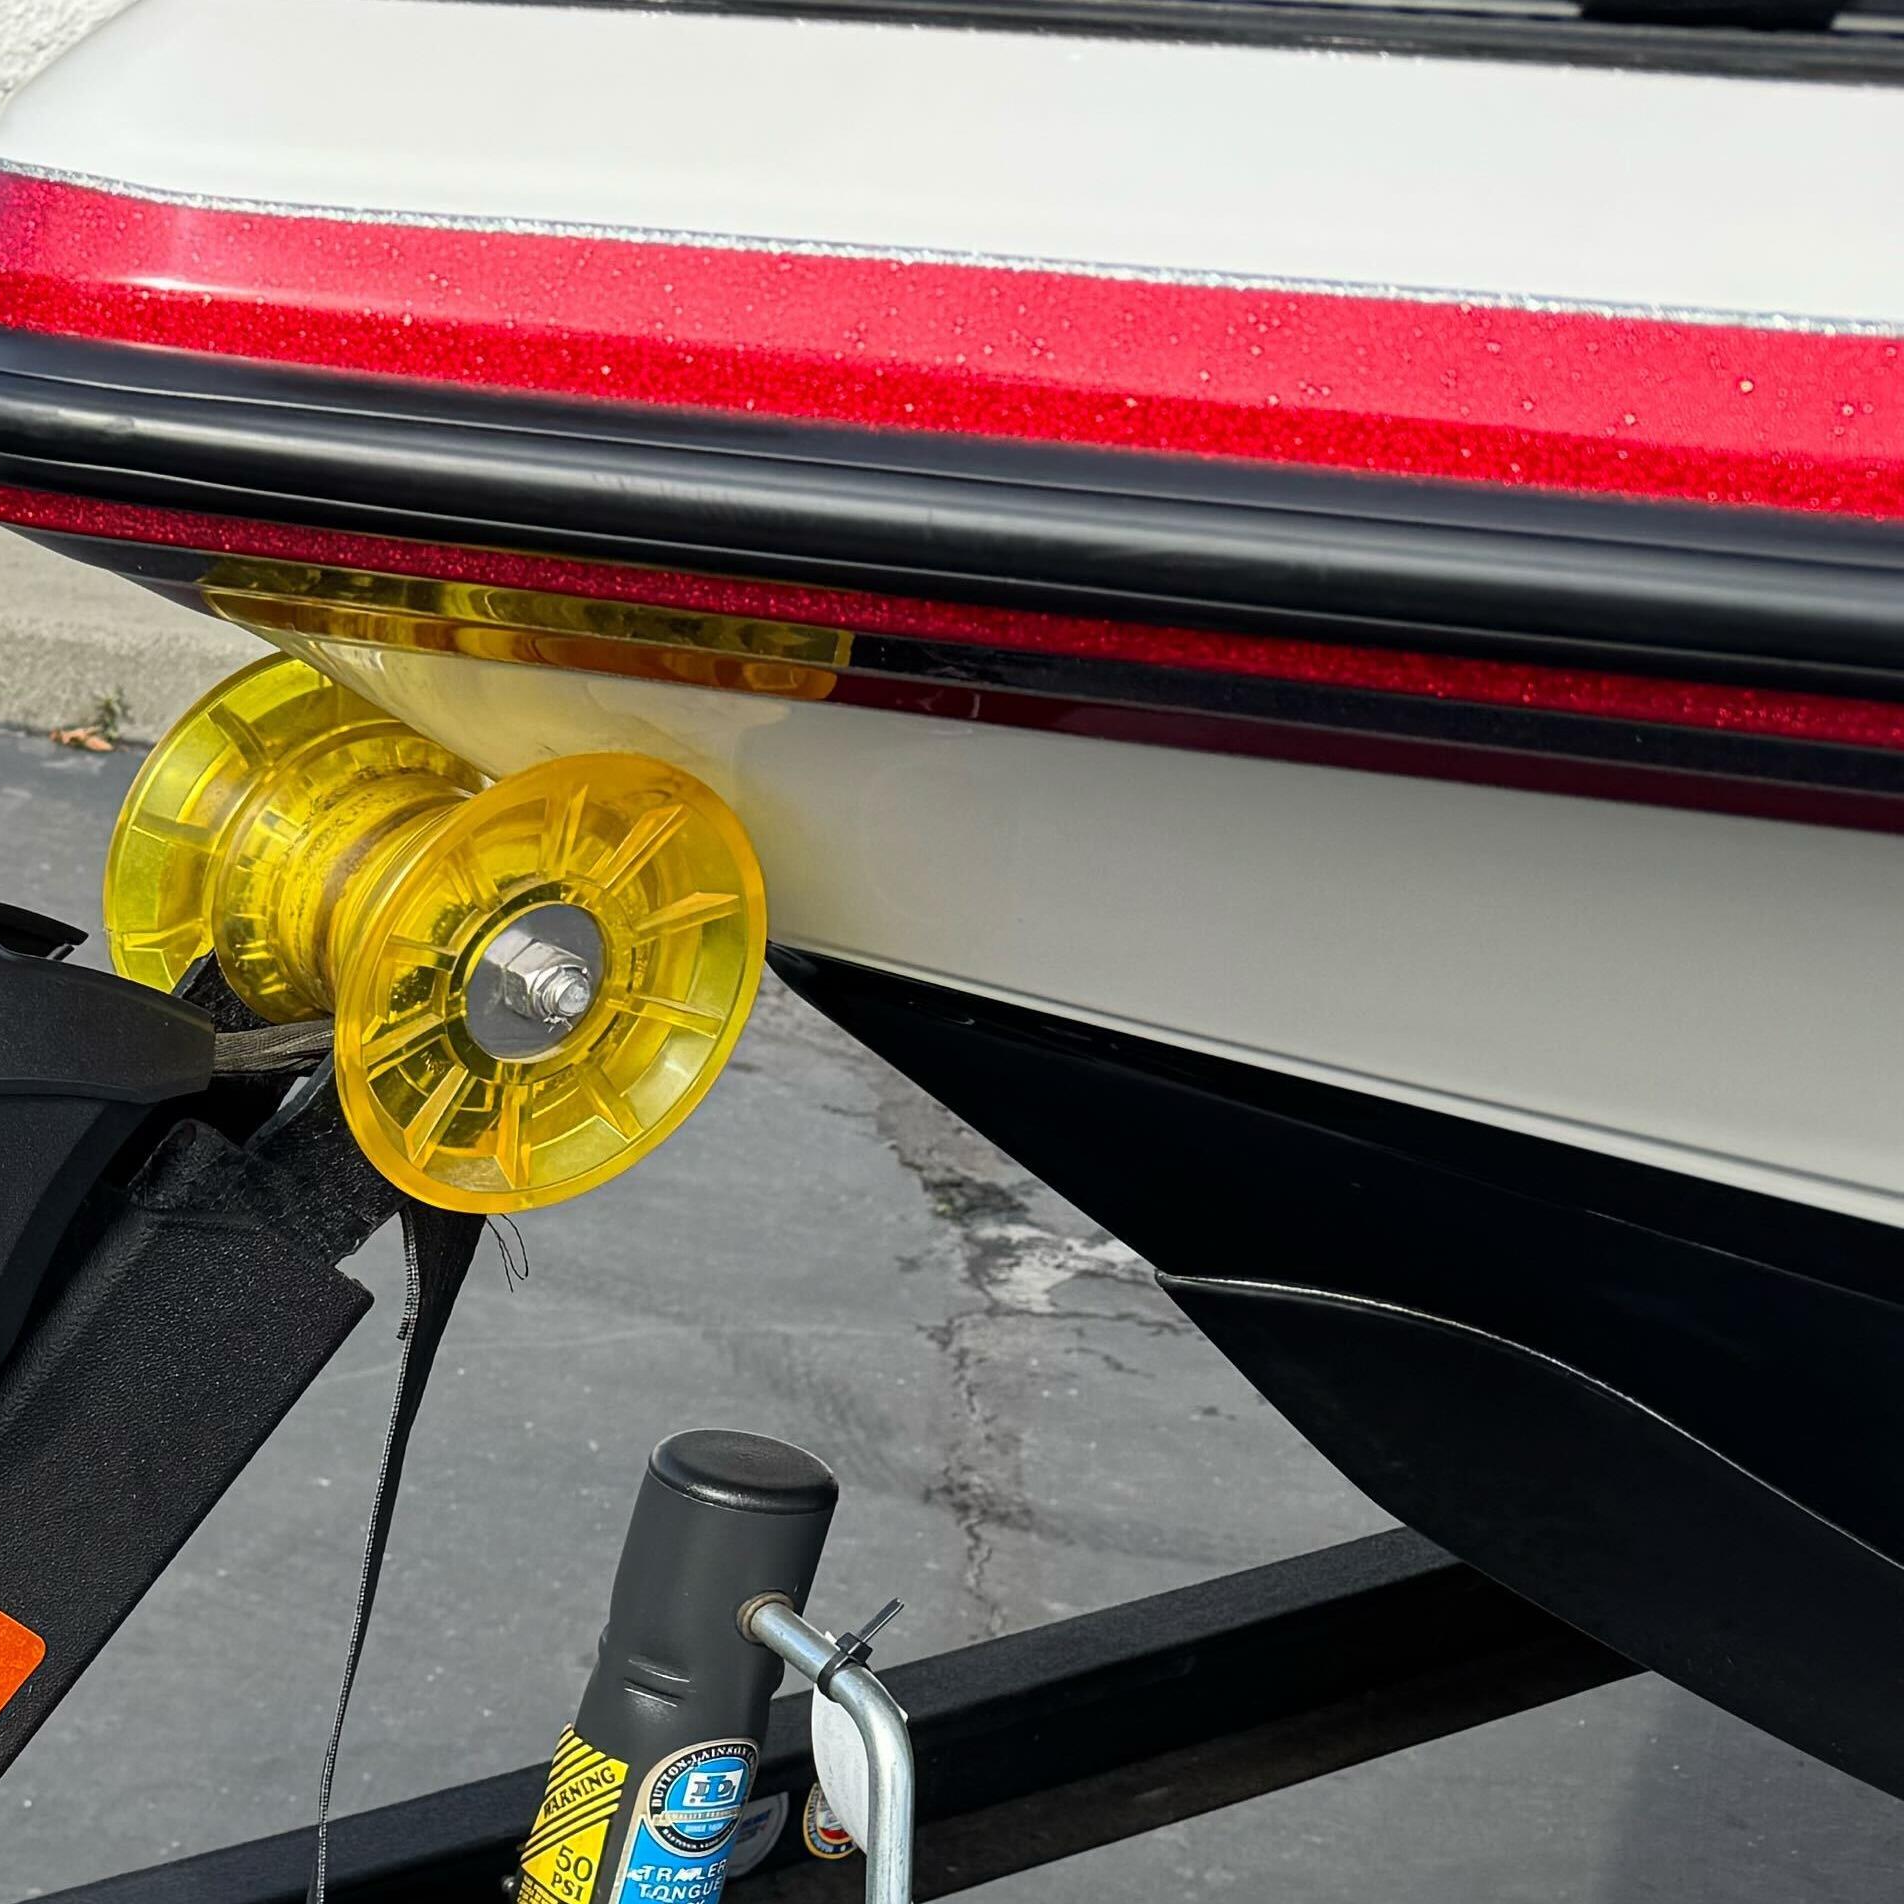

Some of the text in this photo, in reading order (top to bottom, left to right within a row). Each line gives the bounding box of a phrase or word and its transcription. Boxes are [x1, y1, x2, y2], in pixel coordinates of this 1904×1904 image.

[555, 1844, 593, 1882] 50
[550, 1870, 585, 1902] PSI
[639, 1878, 722, 1902] TONGUE
